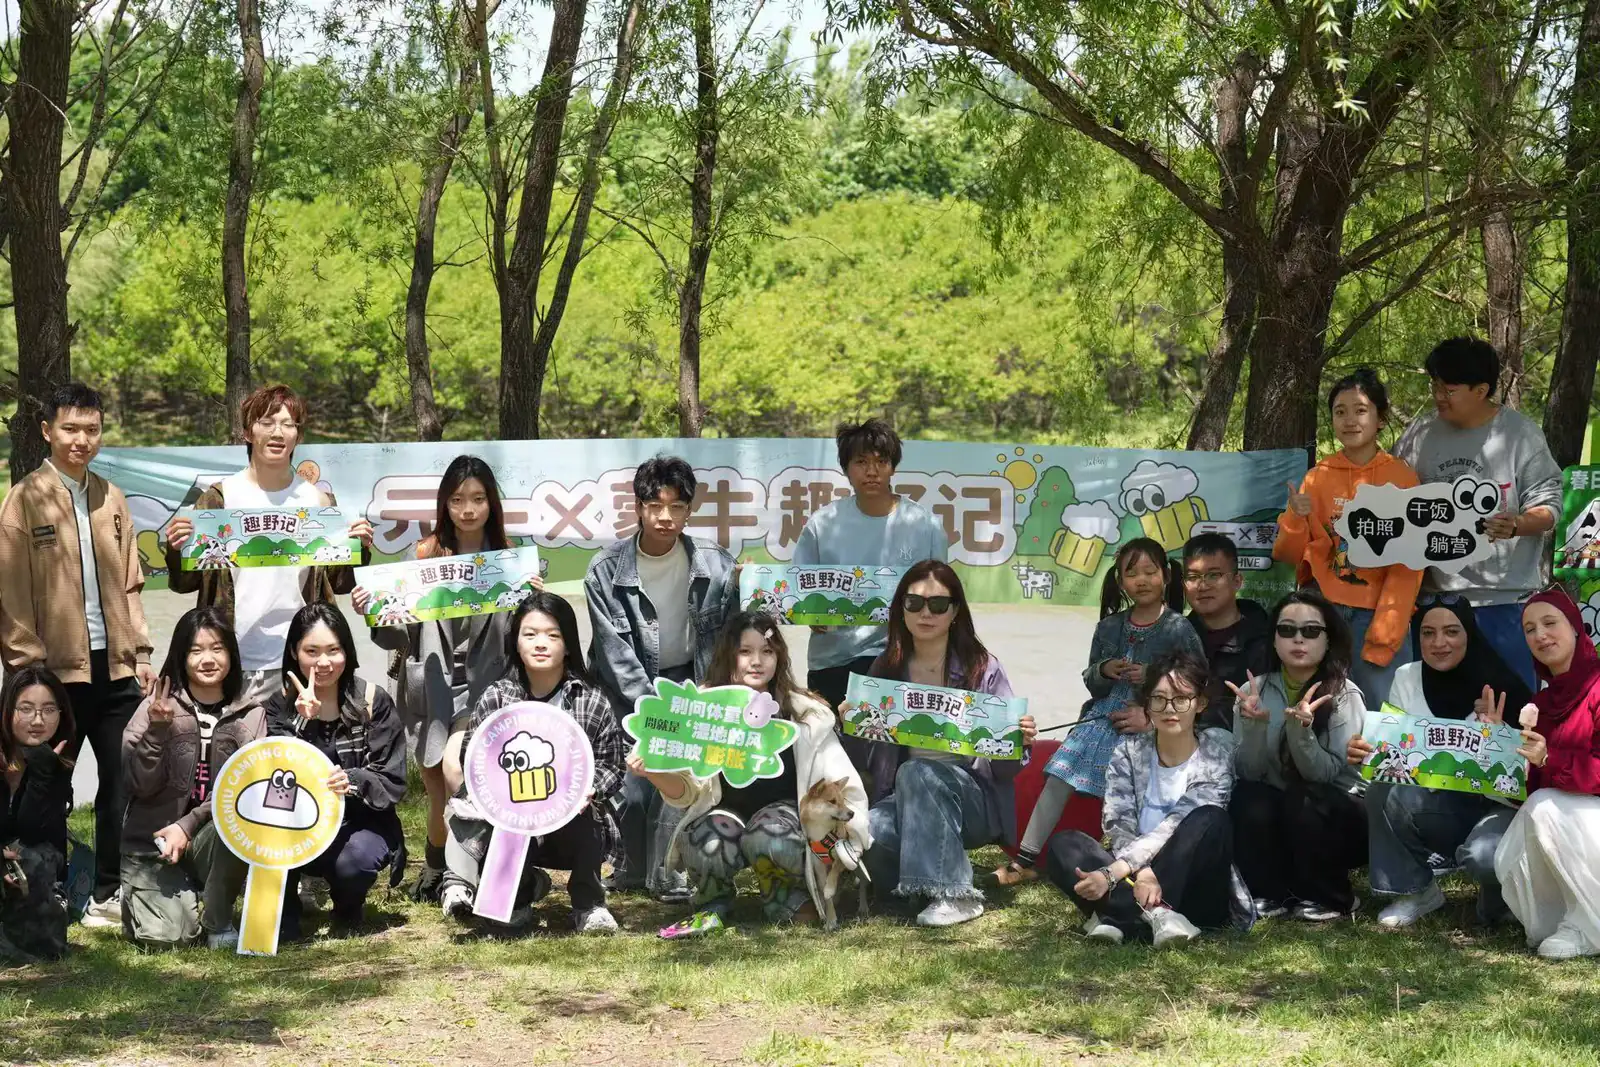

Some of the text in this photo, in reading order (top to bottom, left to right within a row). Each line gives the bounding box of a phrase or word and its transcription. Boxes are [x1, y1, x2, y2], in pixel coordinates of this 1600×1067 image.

[1438, 457, 1483, 473] PEANUTS
[1410, 501, 1449, 520] 干饭
[243, 514, 297, 534] 趣野记
[1356, 517, 1394, 537] 拍照
[1430, 536, 1469, 554] 躺营
[419, 563, 475, 585] 趣野记
[799, 572, 853, 592] 趣野记
[670, 695, 741, 724] 别问体重
[906, 691, 963, 717] 趣野记
[1427, 727, 1482, 753] 趣野记
[472, 749, 502, 815] MENGNIU
[221, 788, 255, 852] MENGNIU
